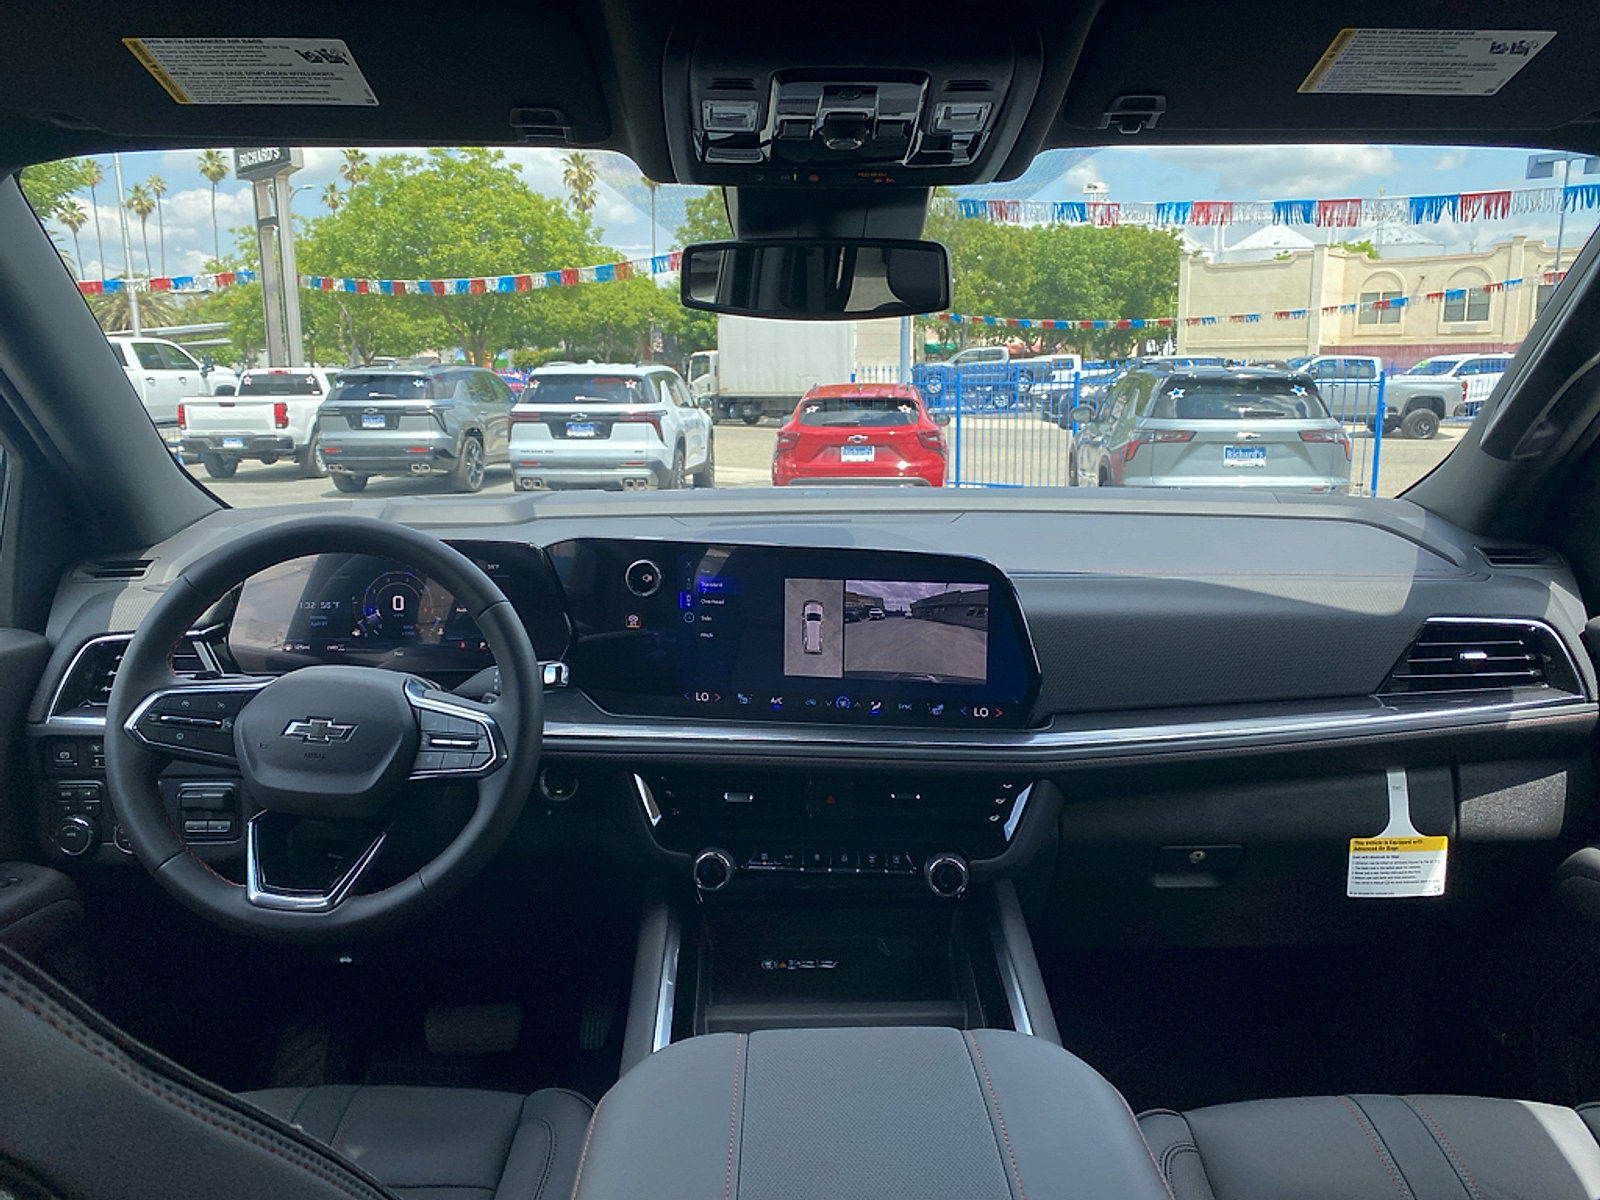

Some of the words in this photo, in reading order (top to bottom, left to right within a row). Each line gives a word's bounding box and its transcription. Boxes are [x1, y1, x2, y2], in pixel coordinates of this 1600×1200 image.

[1226, 448, 1265, 459] Richard's
[701, 580, 723, 588] Standard
[392, 594, 404, 611] 0
[695, 691, 710, 703] LO
[770, 696, 783, 705] A/C
[973, 706, 989, 717] LO
